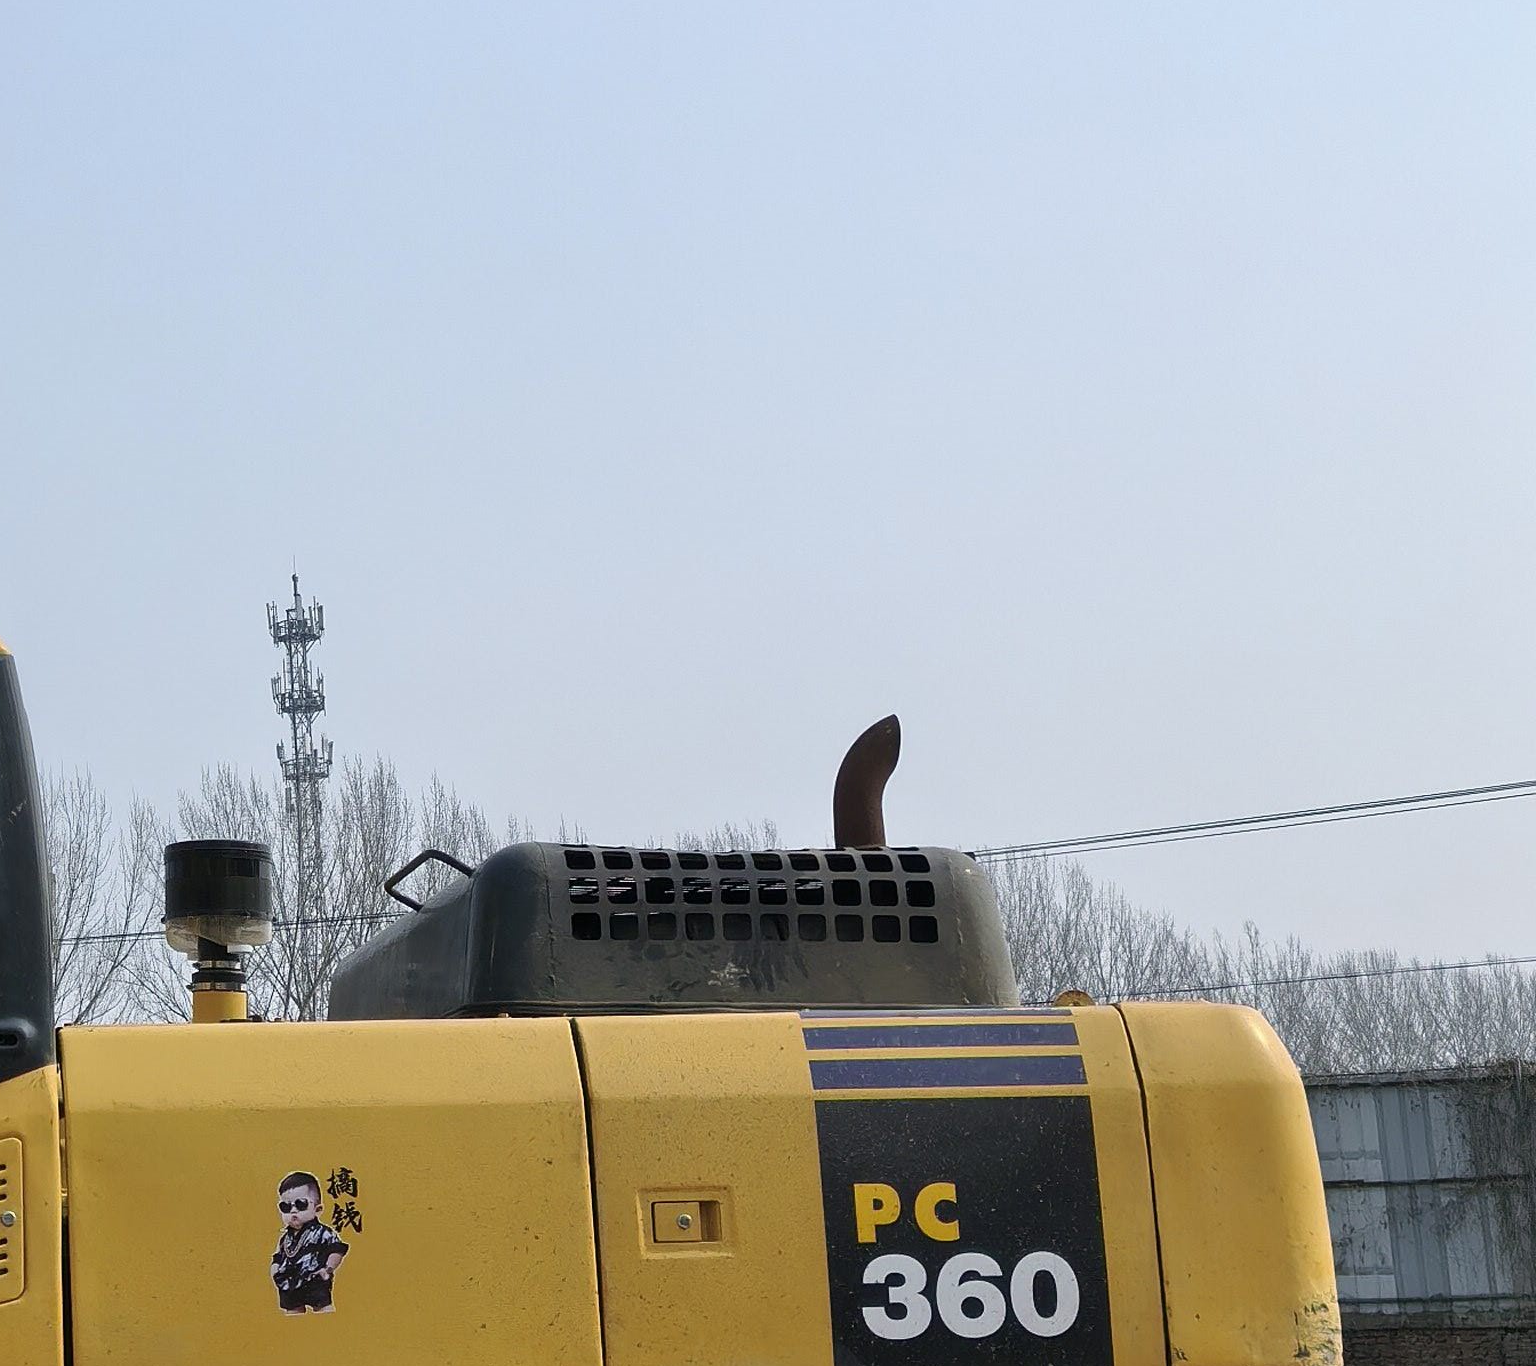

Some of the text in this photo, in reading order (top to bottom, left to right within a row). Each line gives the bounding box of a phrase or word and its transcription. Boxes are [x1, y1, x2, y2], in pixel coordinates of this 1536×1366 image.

[326, 1167, 362, 1234] 搞钱
[853, 1182, 960, 1243] PC
[861, 1251, 1080, 1340] 360
